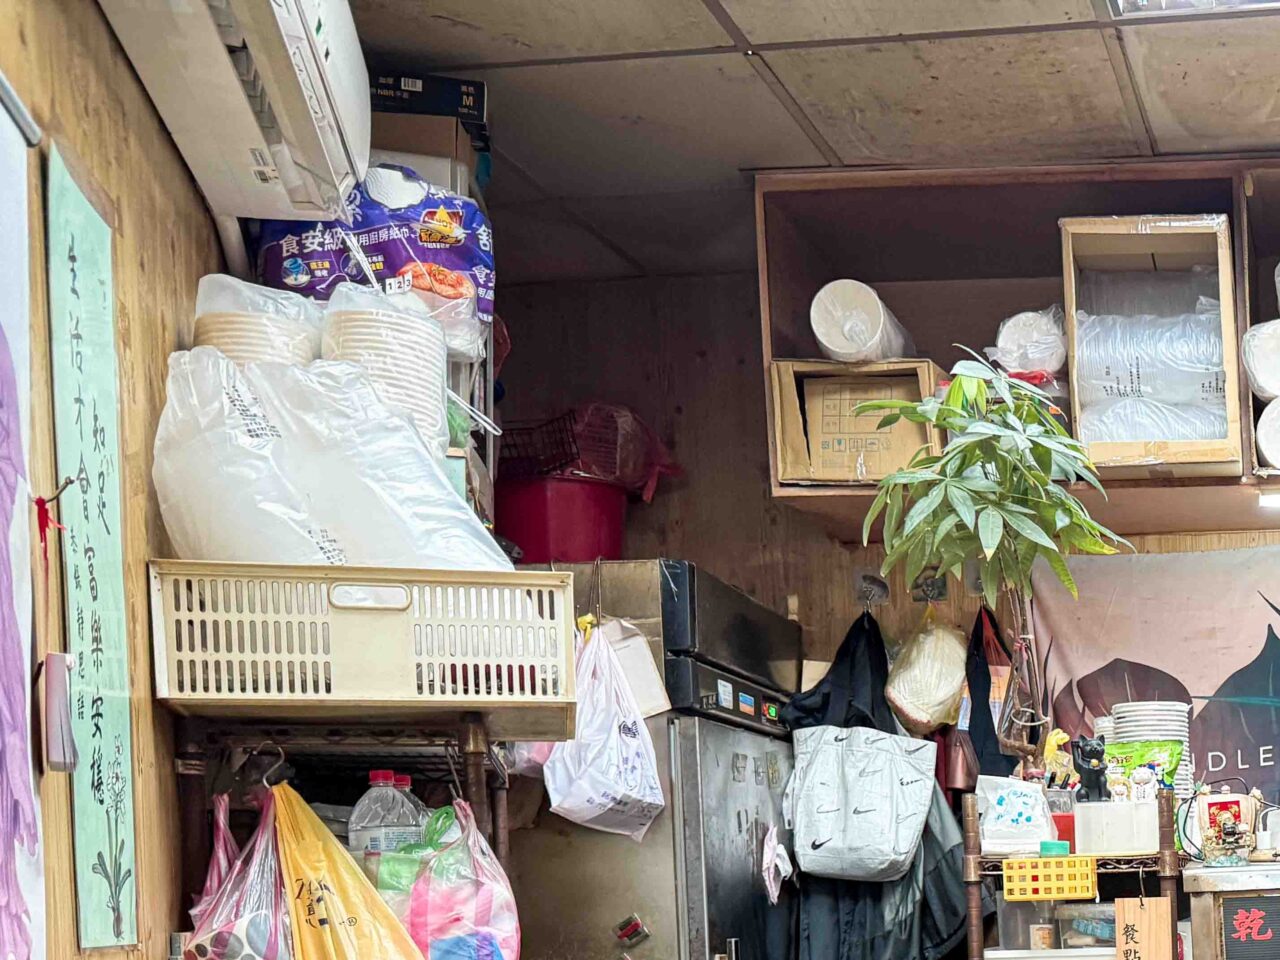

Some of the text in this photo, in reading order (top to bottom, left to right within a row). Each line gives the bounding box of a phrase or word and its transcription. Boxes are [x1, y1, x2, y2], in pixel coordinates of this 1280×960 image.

[280, 226, 344, 257] 食安級
[346, 226, 409, 247] 用廚房紙巾
